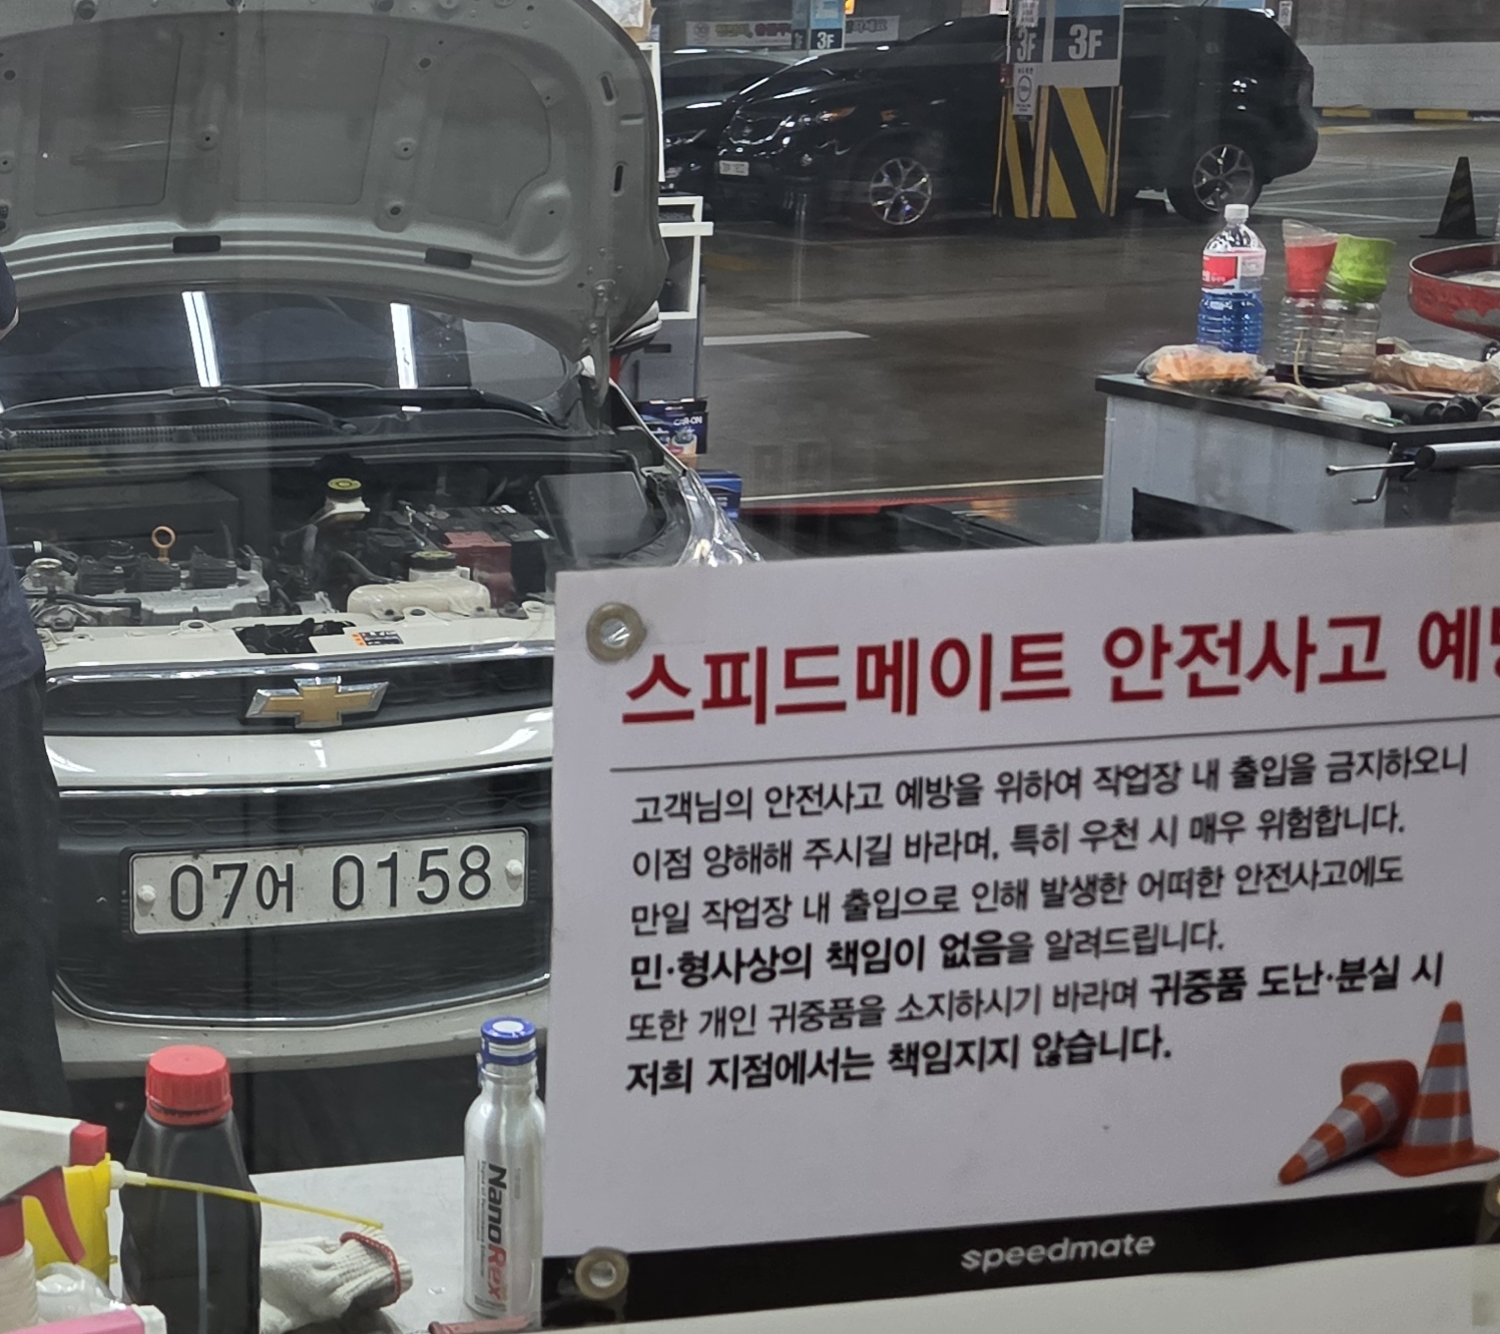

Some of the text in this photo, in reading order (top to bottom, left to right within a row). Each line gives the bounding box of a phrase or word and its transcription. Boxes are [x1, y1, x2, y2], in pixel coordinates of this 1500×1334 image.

[816, 31, 835, 49] 3F
[1068, 24, 1102, 60] 3F
[622, 631, 1071, 725] 스피드메이트
[1102, 615, 1387, 703] 안전사고
[631, 742, 1468, 825] 고객님의 안전사고 예방을 위하여 작업장 내 출입을 금지하오니
[632, 801, 1405, 882] 이점 양해해 주시길 바라며, 특히 우천 시 매우 위험합니다.
[170, 844, 492, 922] 07어 0158
[631, 855, 1403, 938] 만일 작업장 내 출입으로 인해 발생한 어떠한 안전사고에도
[826, 935, 925, 976] 책임이
[939, 929, 1034, 968] 없음을
[1045, 919, 1224, 961] 알려드립니다.
[626, 1008, 688, 1042] 또한
[699, 1003, 756, 1039] 개인
[768, 994, 886, 1034] 귀중품을
[895, 983, 1041, 1023] 소지하시기
[1053, 975, 1138, 1014] 바라며
[1148, 966, 1248, 1008] 귀중품
[1411, 951, 1445, 988] 시
[626, 1024, 1172, 1097] 저희 지점에서는 책임지지 않습니다.
[488, 1163, 507, 1301] NanoRex
[960, 1232, 1156, 1275] speedmate
